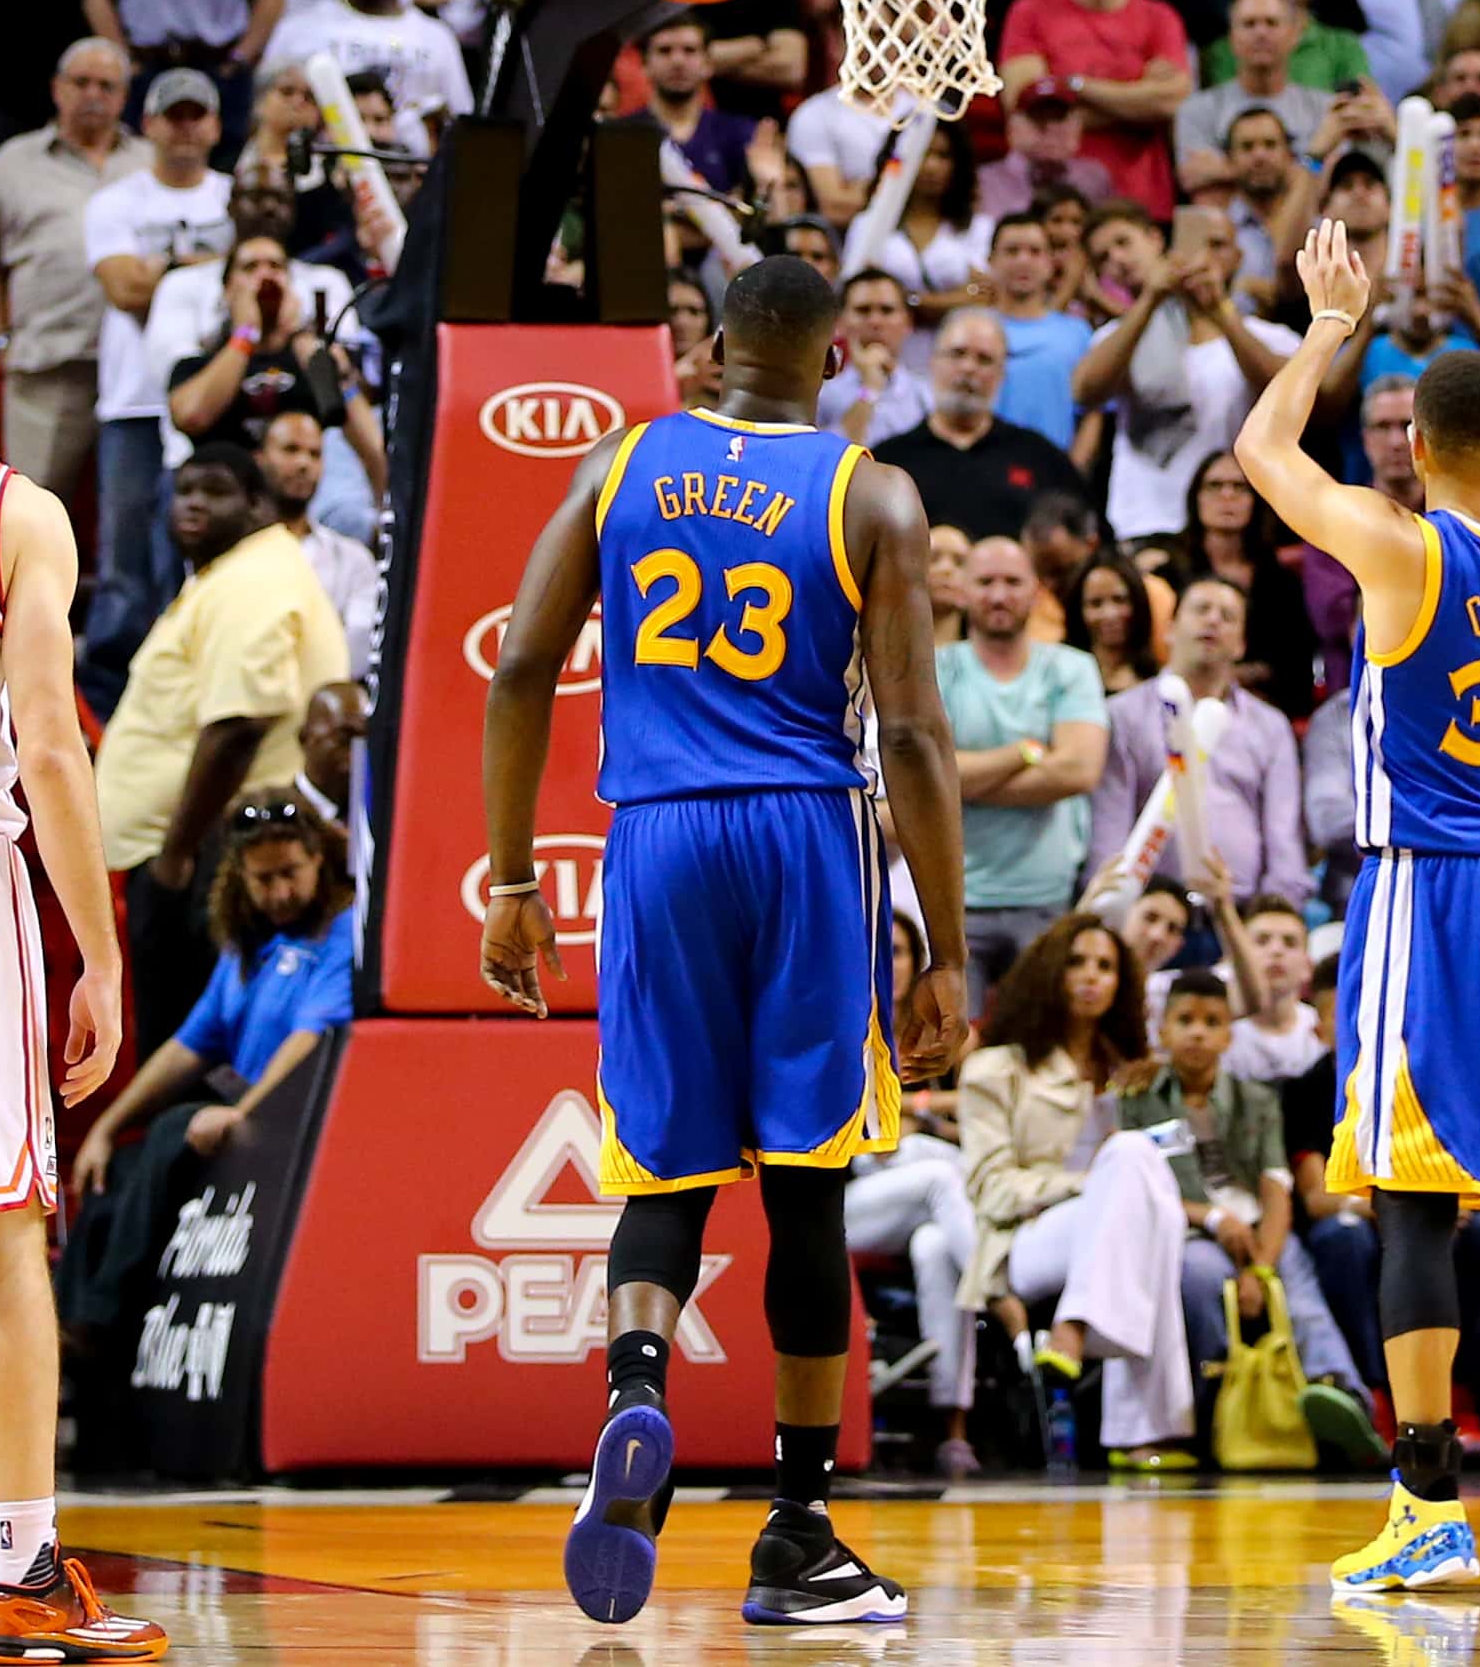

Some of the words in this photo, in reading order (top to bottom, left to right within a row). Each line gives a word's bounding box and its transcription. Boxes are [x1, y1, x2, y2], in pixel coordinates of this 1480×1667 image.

[505, 398, 600, 440] KIA
[653, 471, 796, 538] GREEN
[630, 546, 794, 682] 23
